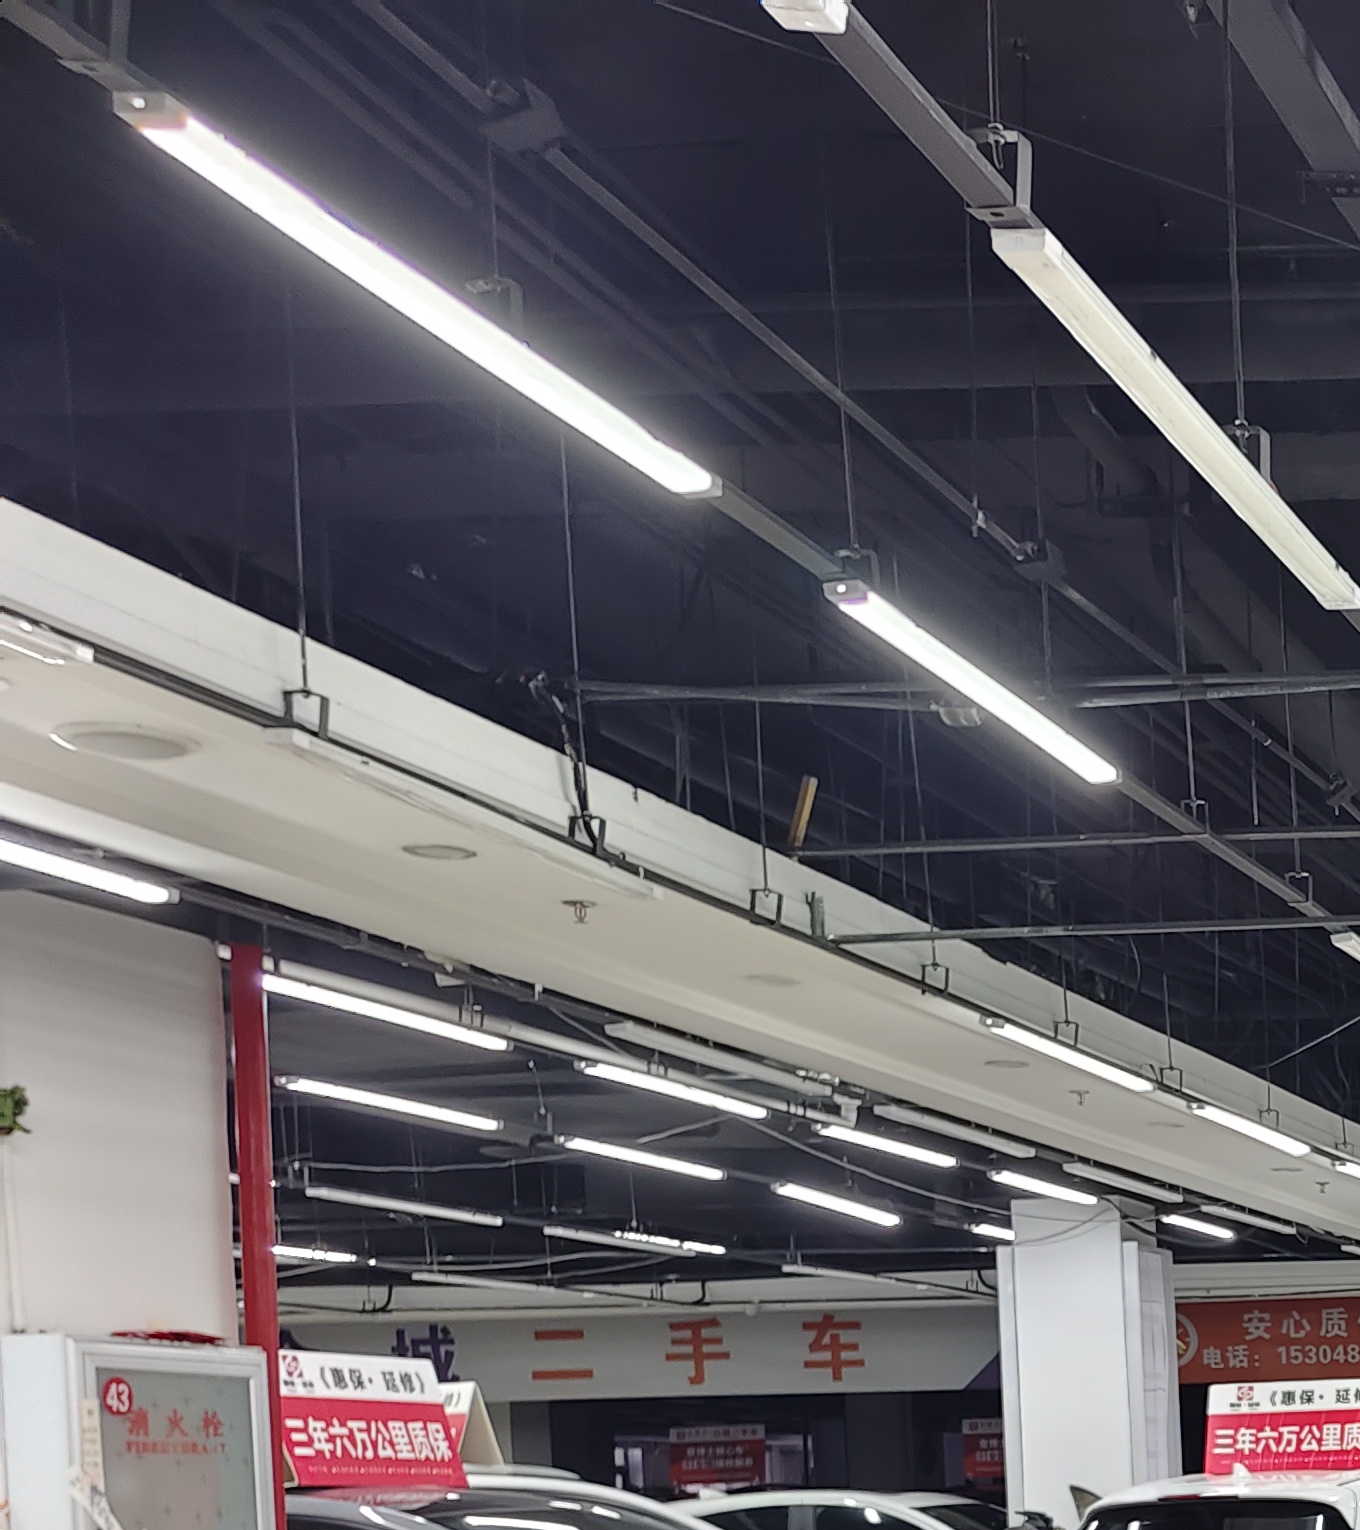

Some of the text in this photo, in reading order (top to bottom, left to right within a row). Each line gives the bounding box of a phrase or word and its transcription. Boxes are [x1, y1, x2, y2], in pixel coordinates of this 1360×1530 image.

[280, 1314, 866, 1386] 城二手车
[106, 1382, 130, 1413] 43
[285, 1416, 453, 1462] 三年六万公里质保
